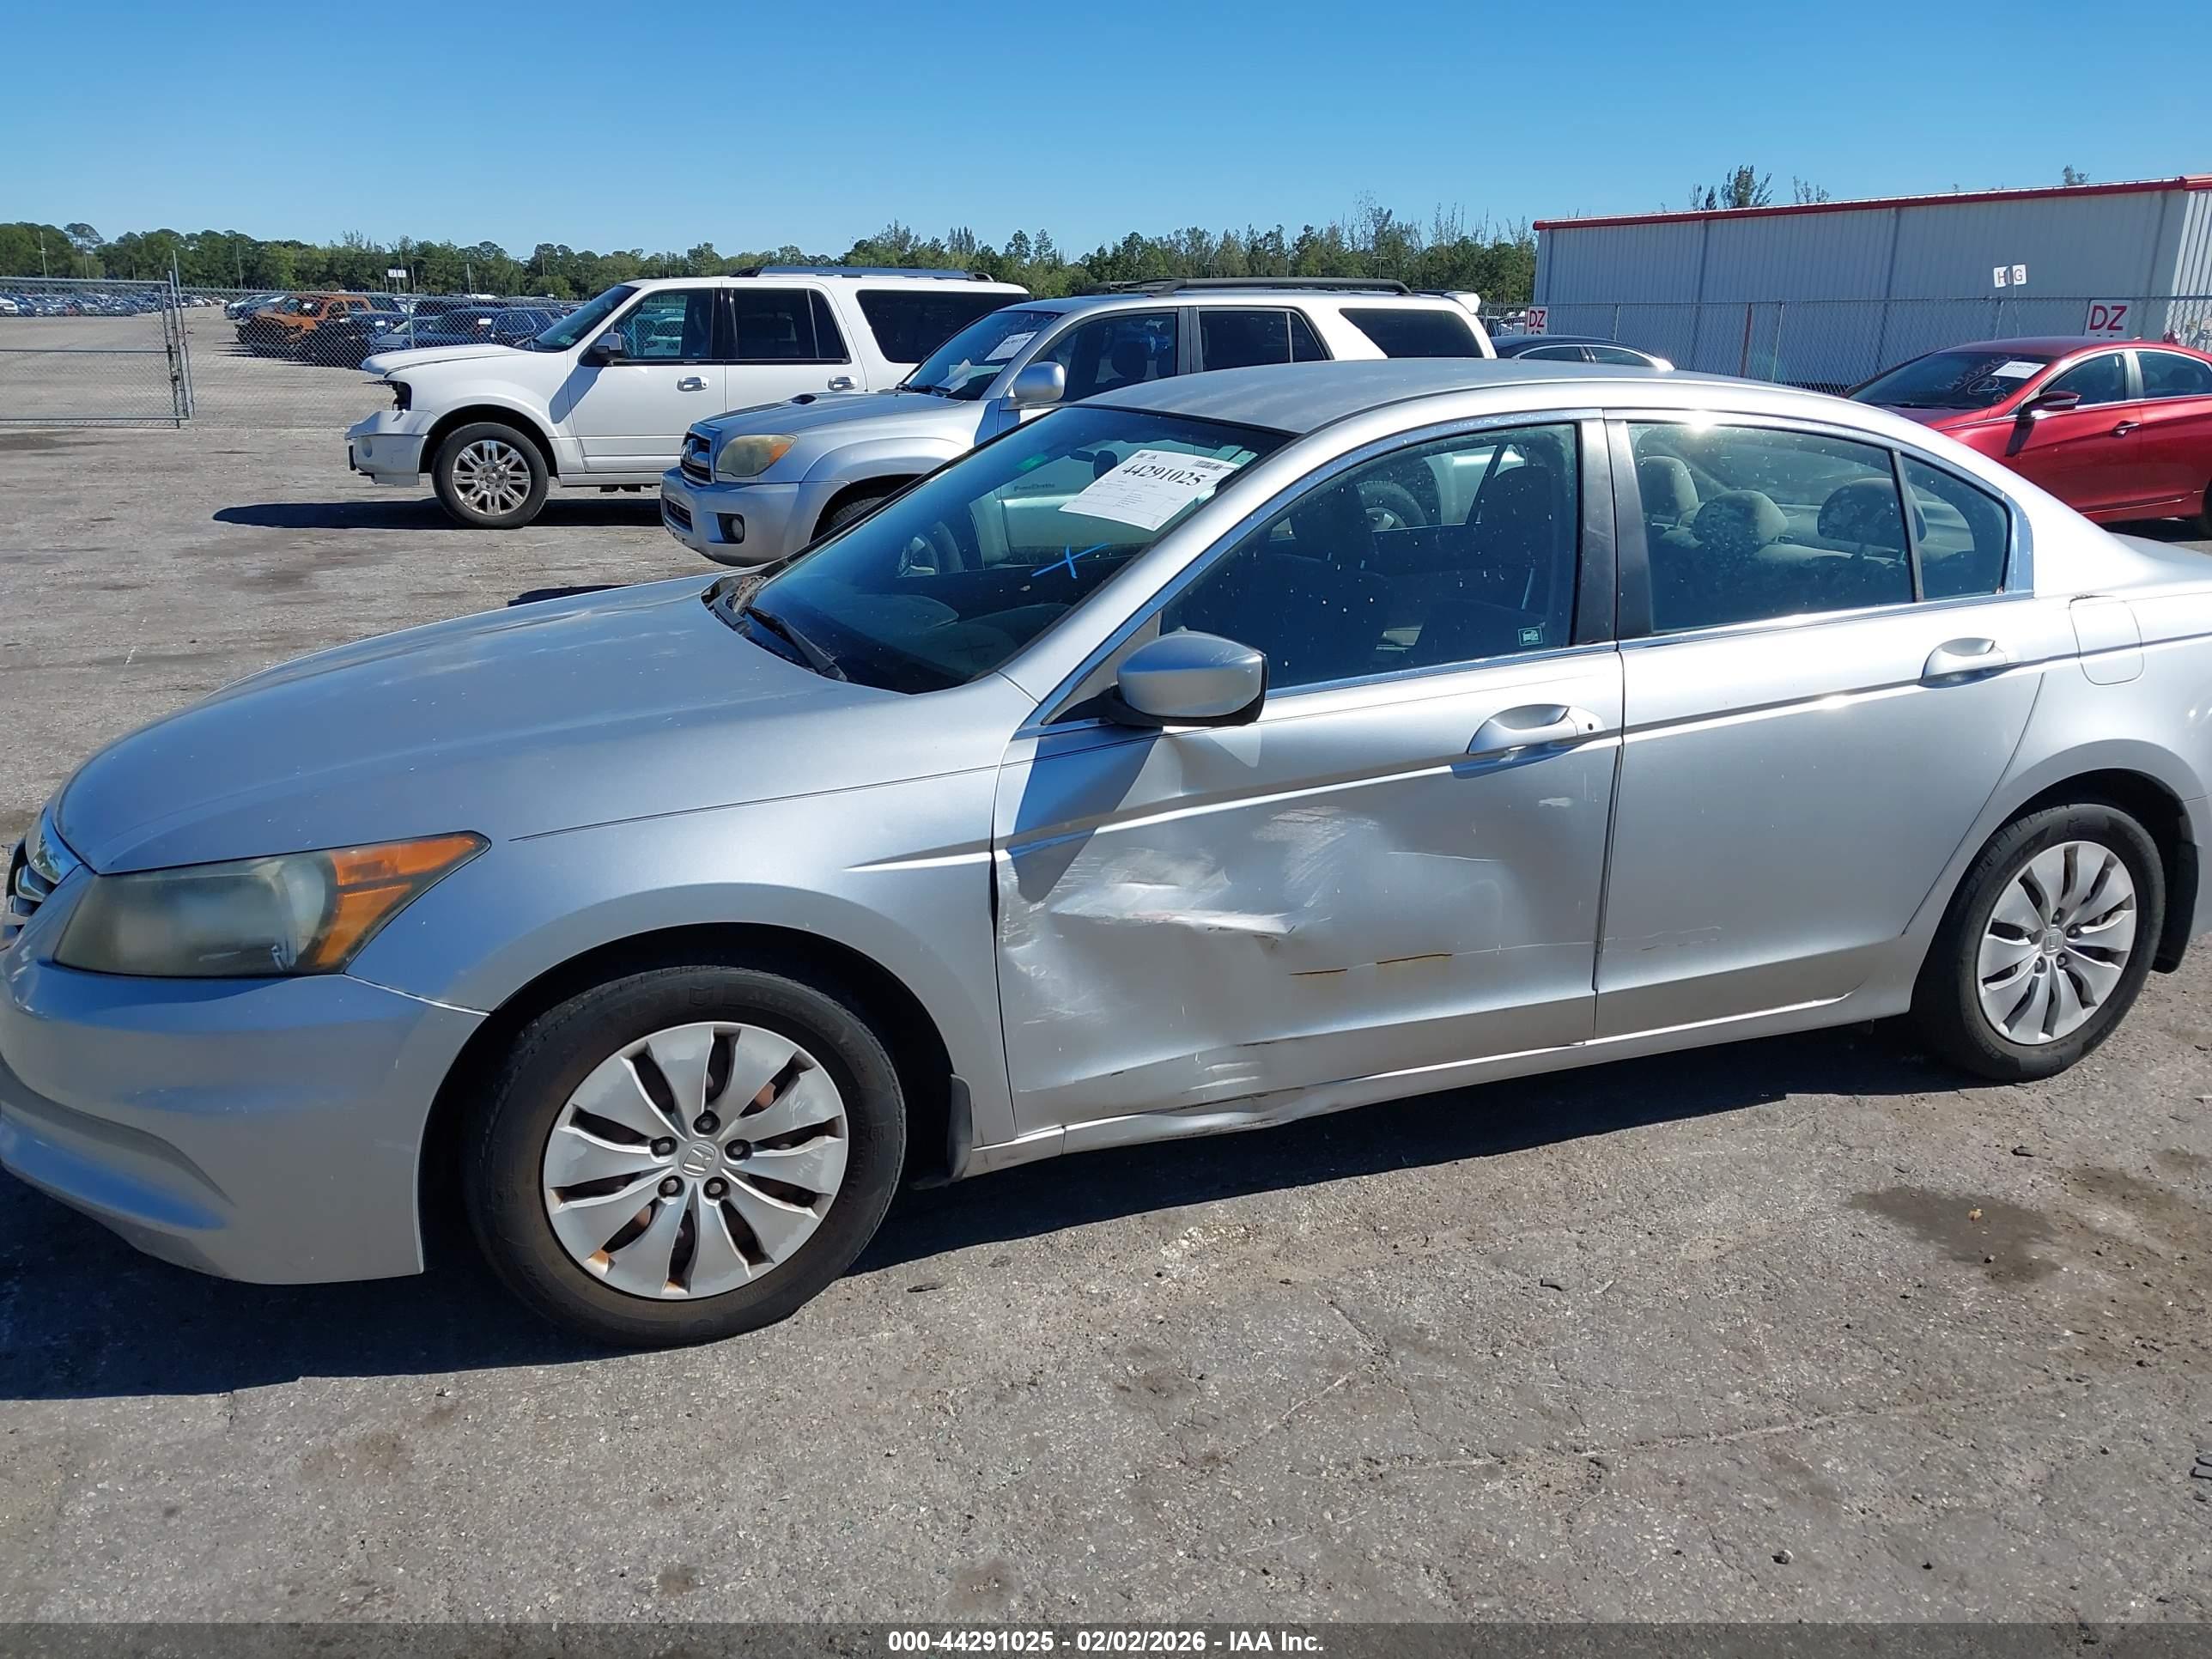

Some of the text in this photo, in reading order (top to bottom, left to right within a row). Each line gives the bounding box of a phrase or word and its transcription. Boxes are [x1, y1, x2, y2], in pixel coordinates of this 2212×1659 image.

[1996, 268, 2023, 284] H G
[1528, 310, 1547, 328] DZ
[2089, 305, 2128, 331] DZ
[1122, 464, 1207, 485] 44291025
